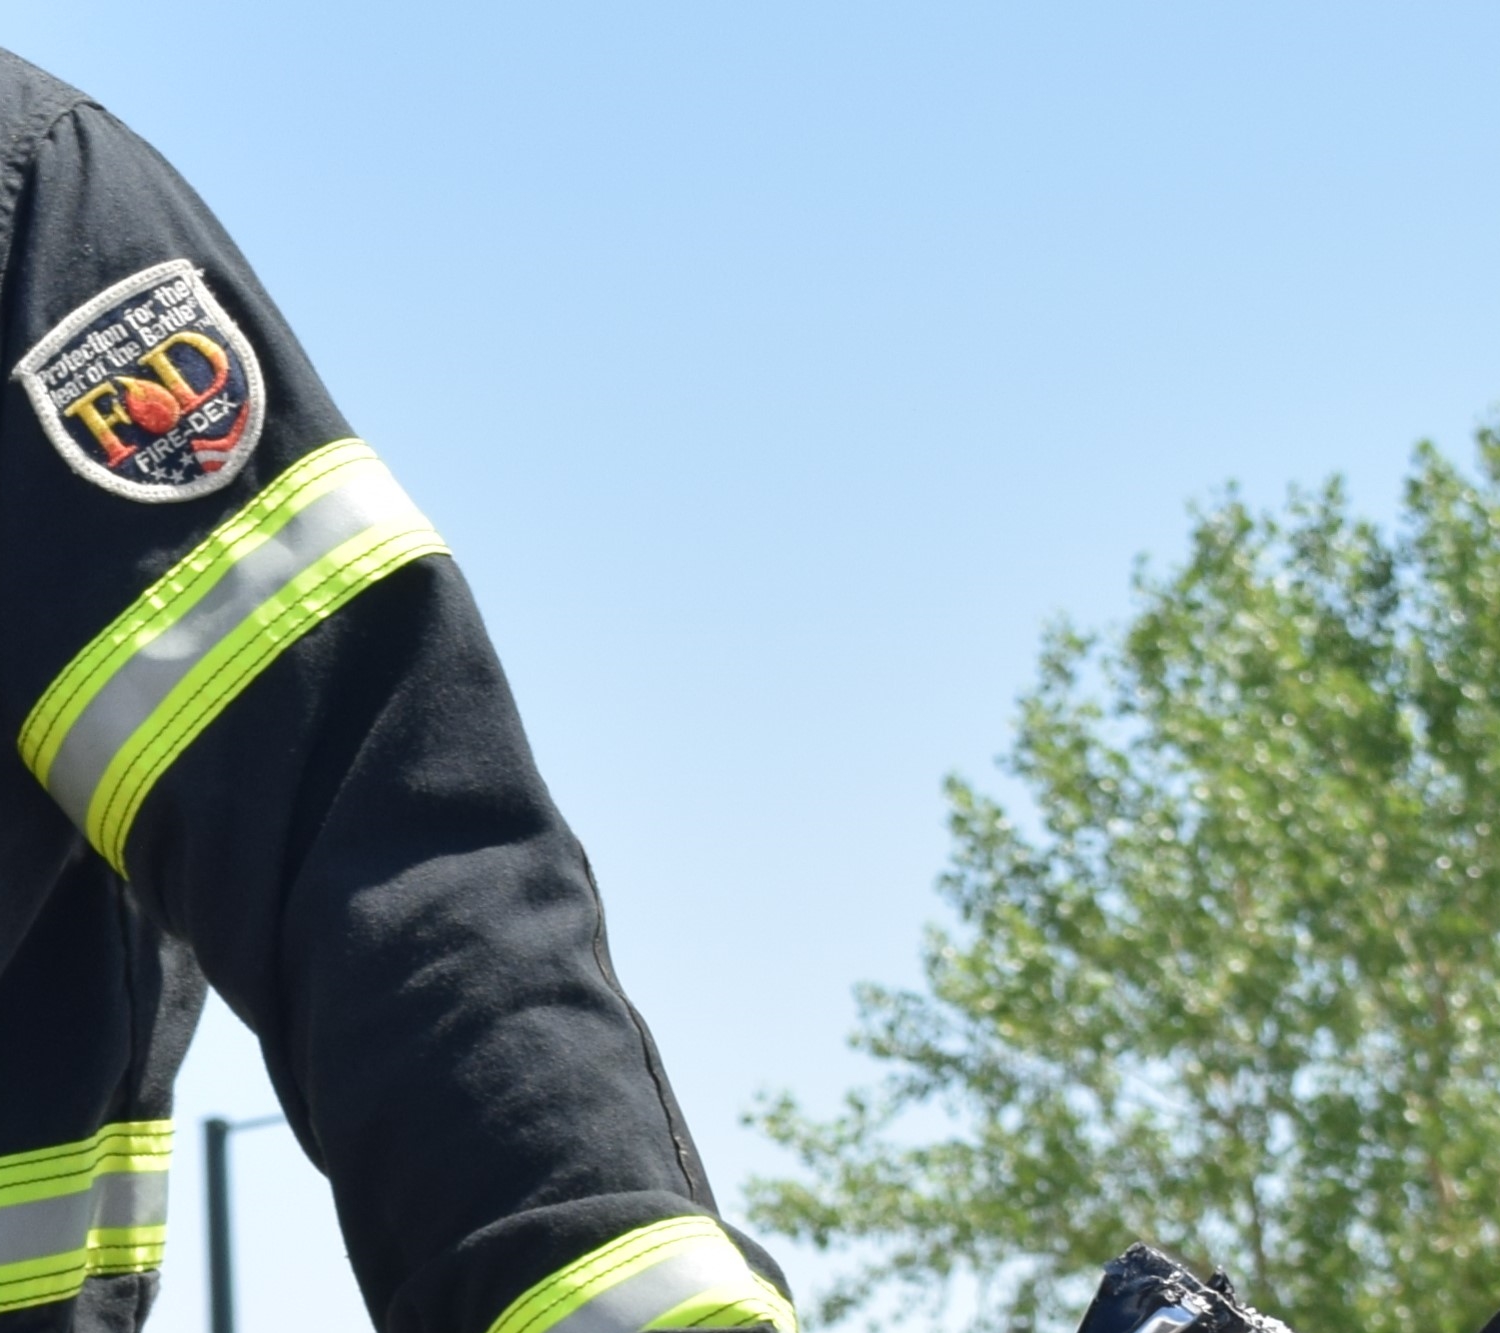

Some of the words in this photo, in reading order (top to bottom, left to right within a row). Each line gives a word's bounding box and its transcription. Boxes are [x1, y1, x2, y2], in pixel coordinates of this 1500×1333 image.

[36, 322, 129, 392] Protection
[124, 300, 156, 331] for
[154, 279, 191, 312] the
[86, 357, 109, 383] of
[106, 339, 143, 368] the
[134, 391, 239, 474] FIRE-DEX
